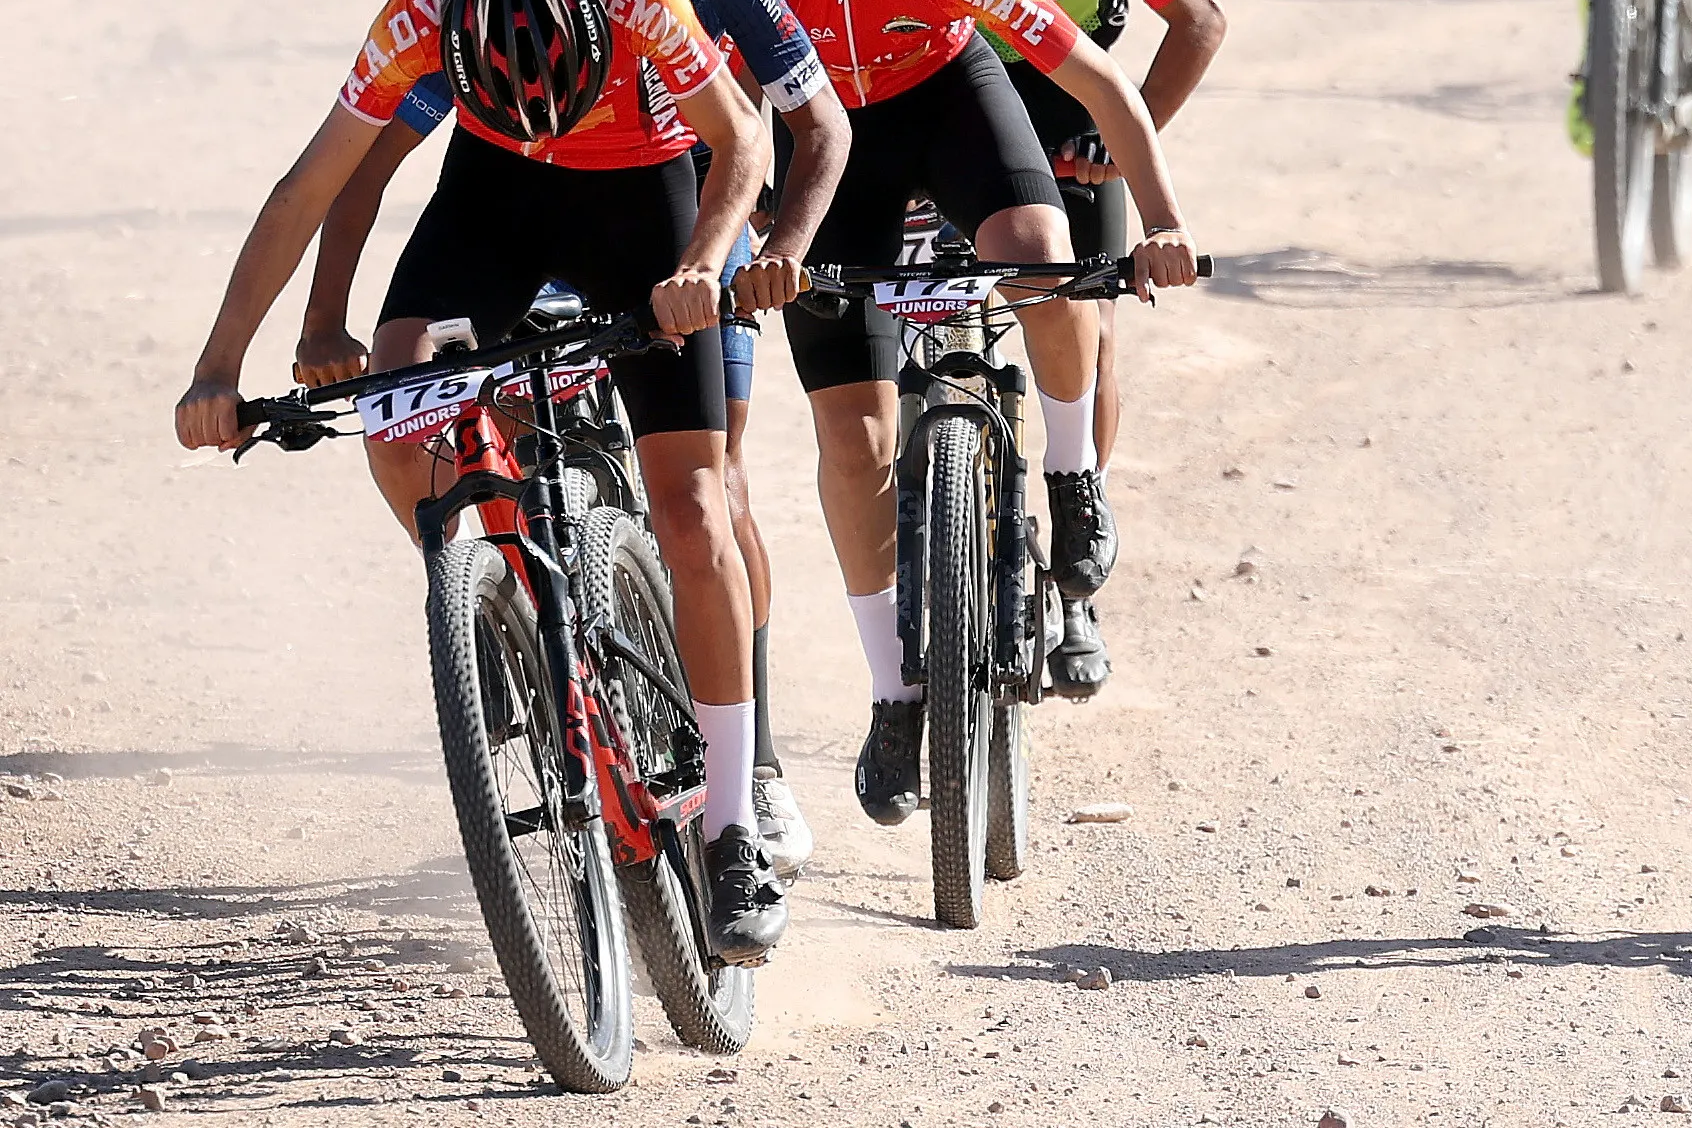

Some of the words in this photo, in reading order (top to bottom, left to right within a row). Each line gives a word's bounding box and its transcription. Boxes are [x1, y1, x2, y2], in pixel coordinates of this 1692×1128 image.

[579, 0, 599, 42] GIRO
[453, 52, 470, 92] GIRO
[886, 279, 979, 297] 174
[891, 300, 968, 314] JUNIORS
[371, 375, 468, 421] 175
[384, 403, 461, 443] JUNIORS
